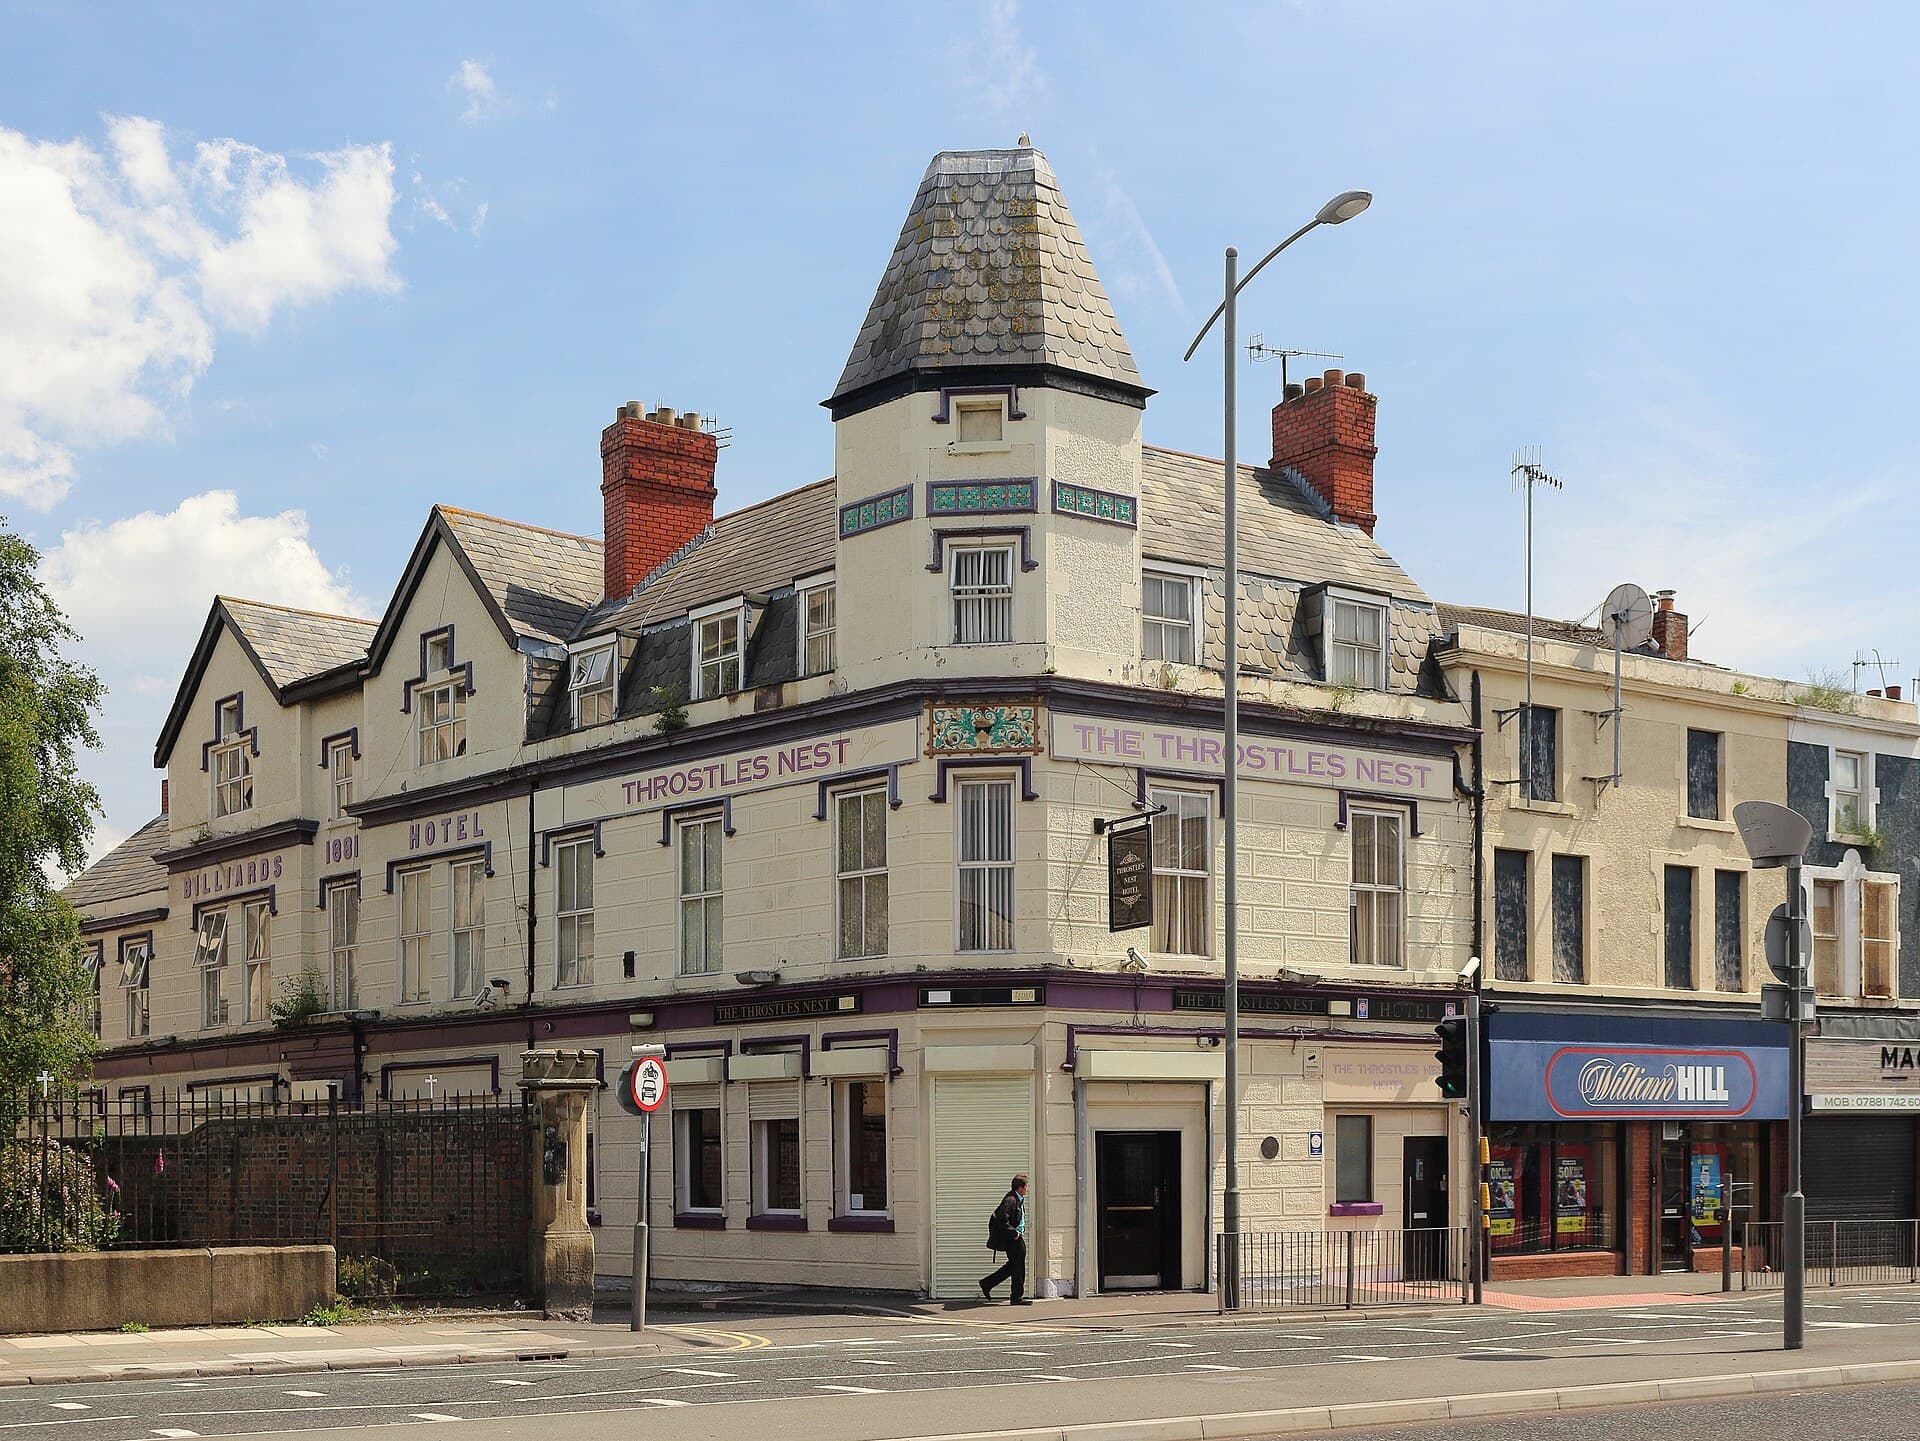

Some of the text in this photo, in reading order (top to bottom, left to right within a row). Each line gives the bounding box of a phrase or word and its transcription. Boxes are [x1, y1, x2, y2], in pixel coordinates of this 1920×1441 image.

[1072, 724, 1144, 758] THE
[1356, 757, 1432, 789] NEST
[621, 738, 851, 805] THROSTLES NEST
[409, 812, 484, 849] HOTEL
[325, 835, 359, 864] 1881
[183, 855, 282, 898] BILLIARDS
[1116, 862, 1145, 875] THROSTLES
[718, 1006, 738, 1020] THE
[740, 1001, 800, 1018] THROSTLES
[803, 999, 831, 1012] NEST
[1179, 994, 1205, 1007] THE
[1283, 998, 1315, 1011] NEST
[1380, 1001, 1435, 1019] HOTEL
[1881, 1046, 1920, 1068] MA
[1332, 1063, 1353, 1074] THE
[1357, 1063, 1418, 1075] THROSTLES
[1578, 1058, 1729, 1103] William HILL
[1856, 1097, 1886, 1107] 07881
[1889, 1097, 1906, 1107] 742
